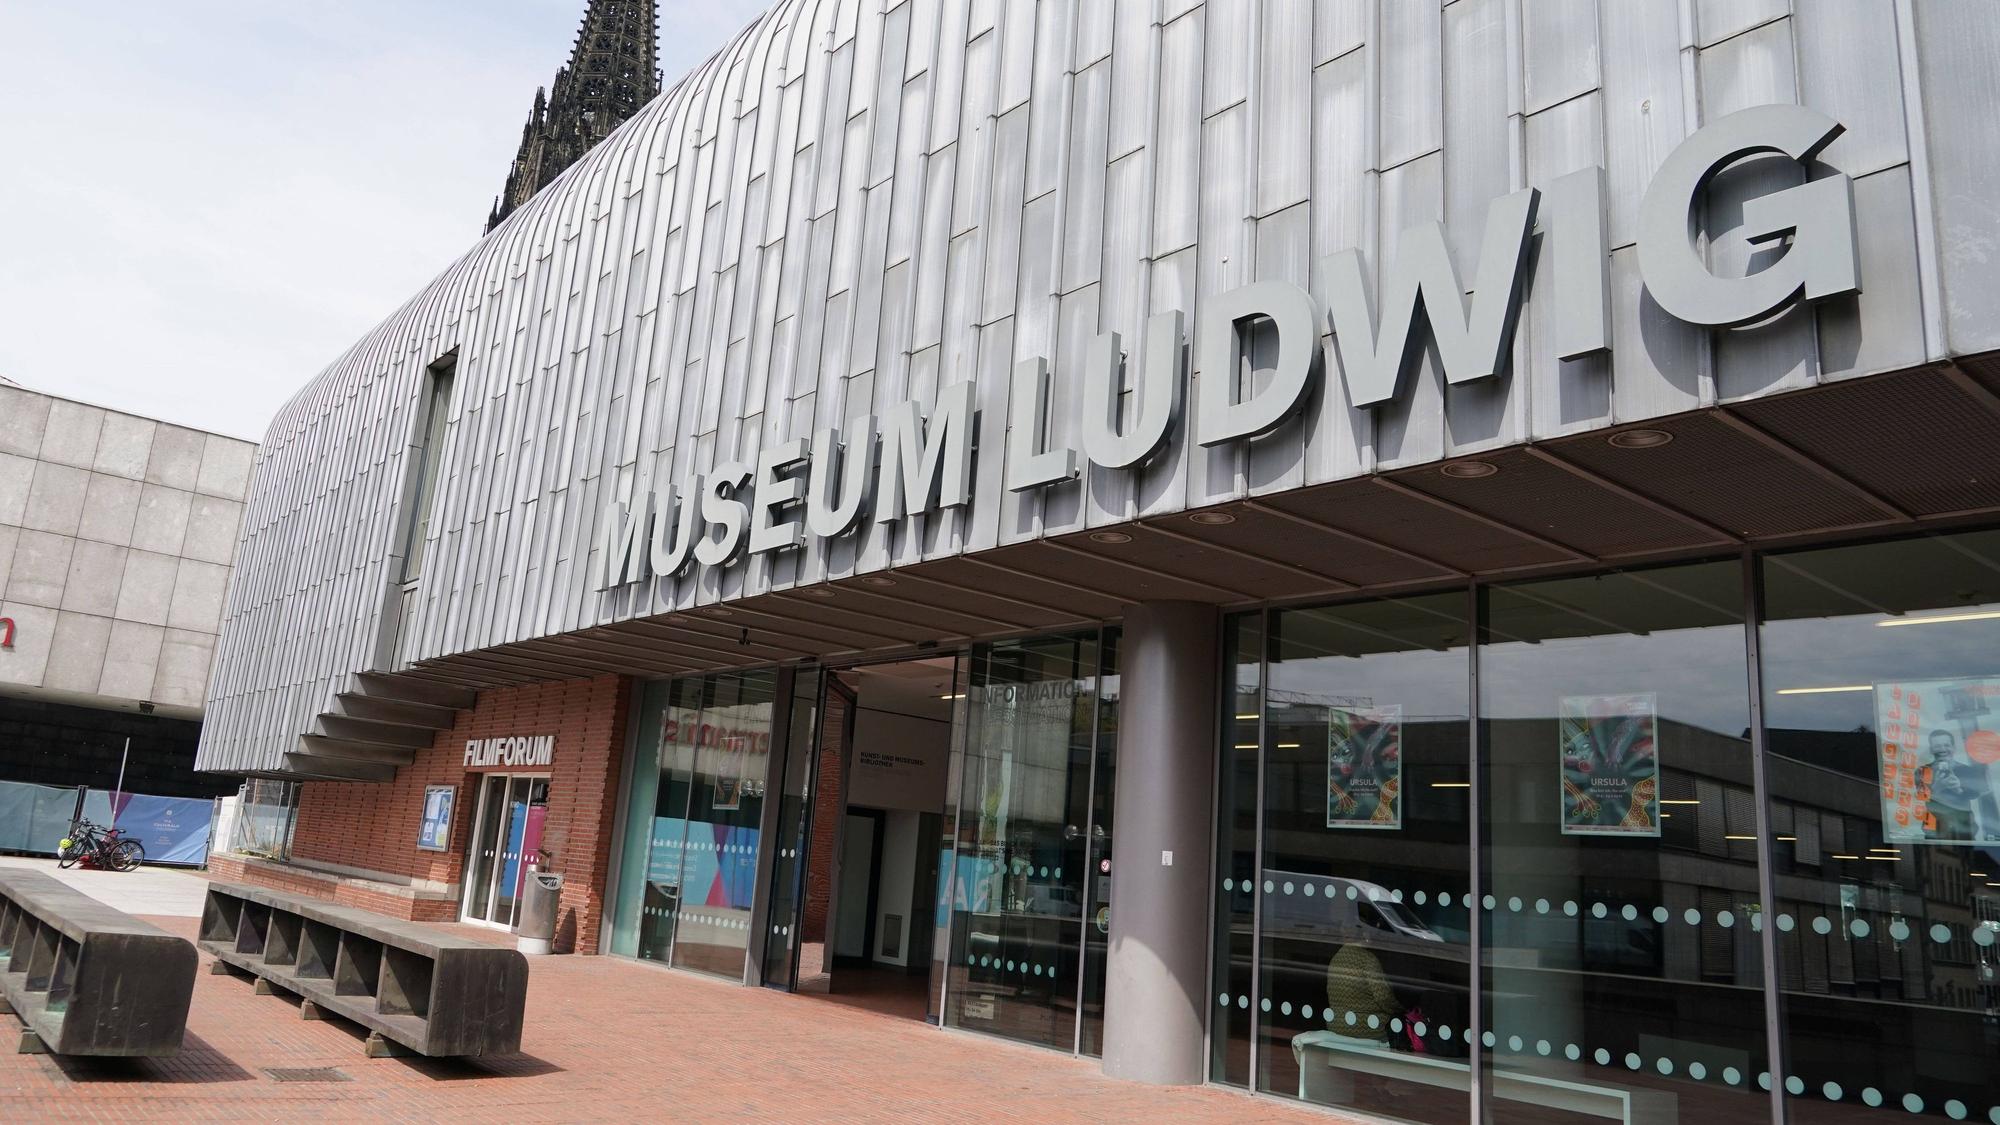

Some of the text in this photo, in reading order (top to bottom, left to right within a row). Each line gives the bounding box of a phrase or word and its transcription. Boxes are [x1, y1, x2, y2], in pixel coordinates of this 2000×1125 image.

[592, 104, 1863, 593] MUSEUM LUDWIG
[463, 735, 555, 767] FILMFORUM
[1349, 778, 1378, 787] URSULA
[1590, 777, 1628, 786] URSULA
